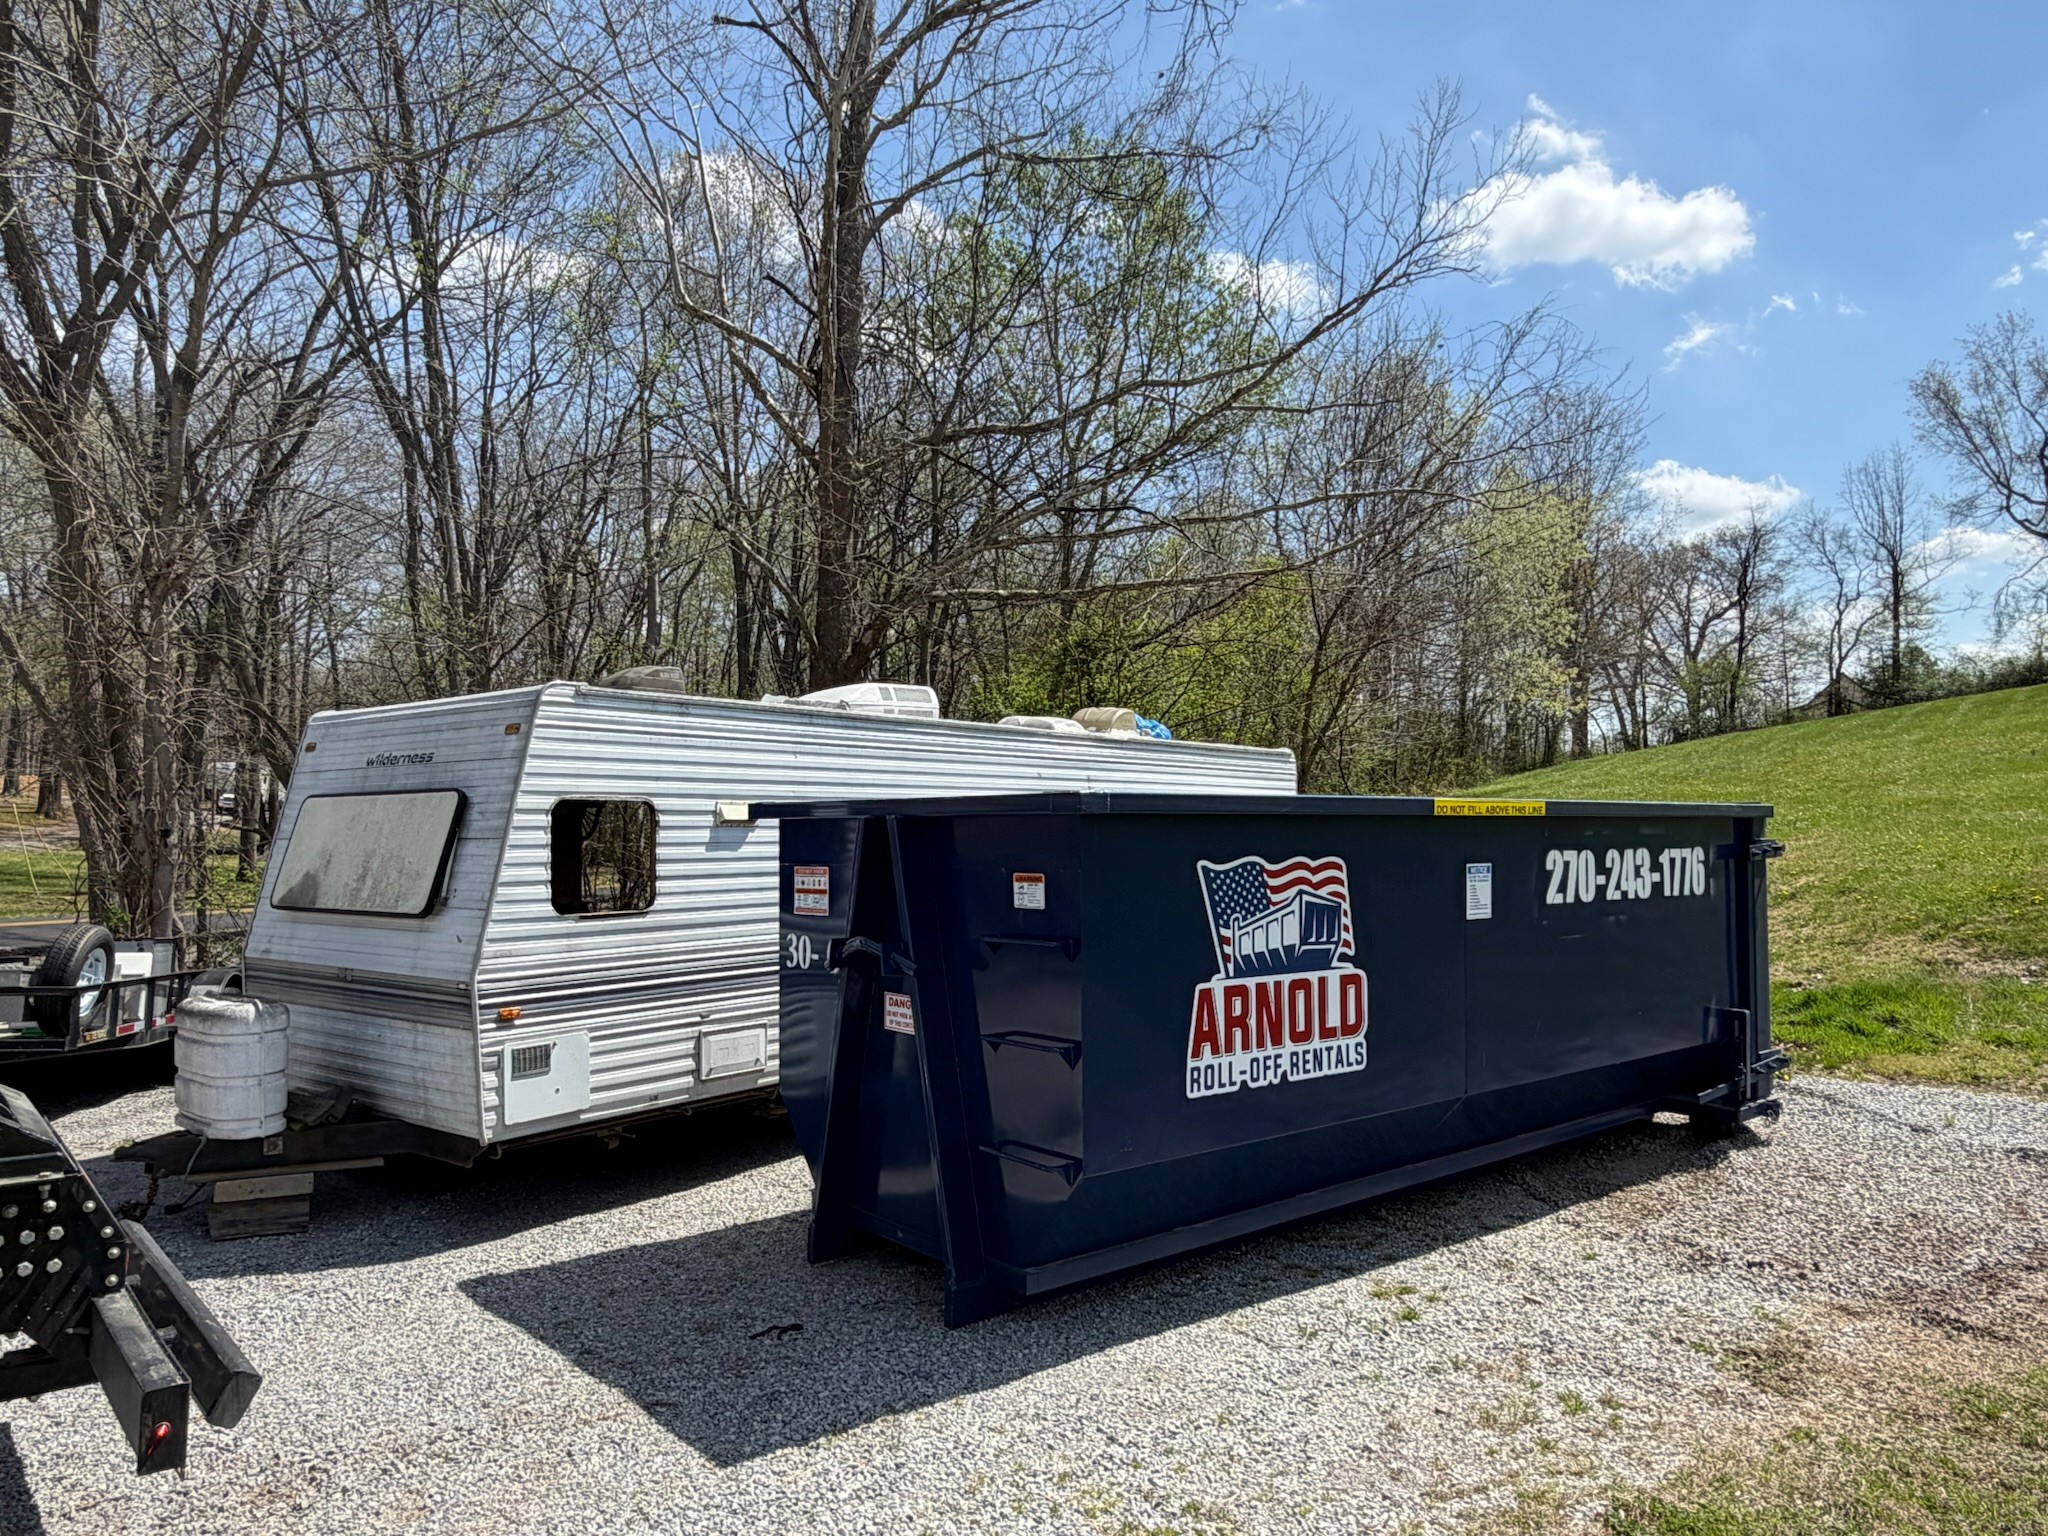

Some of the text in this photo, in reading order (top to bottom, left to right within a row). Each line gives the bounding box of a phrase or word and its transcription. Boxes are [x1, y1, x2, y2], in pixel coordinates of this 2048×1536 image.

[366, 752, 435, 767] wilderness
[1436, 805, 1543, 815] DO NOT FILL ABOVE THIS LINE
[1545, 846, 1706, 905] 270-243-1776
[1190, 973, 1366, 1061] ARNOLD
[1189, 1041, 1365, 1094] ROLL-OFF RENTALS
